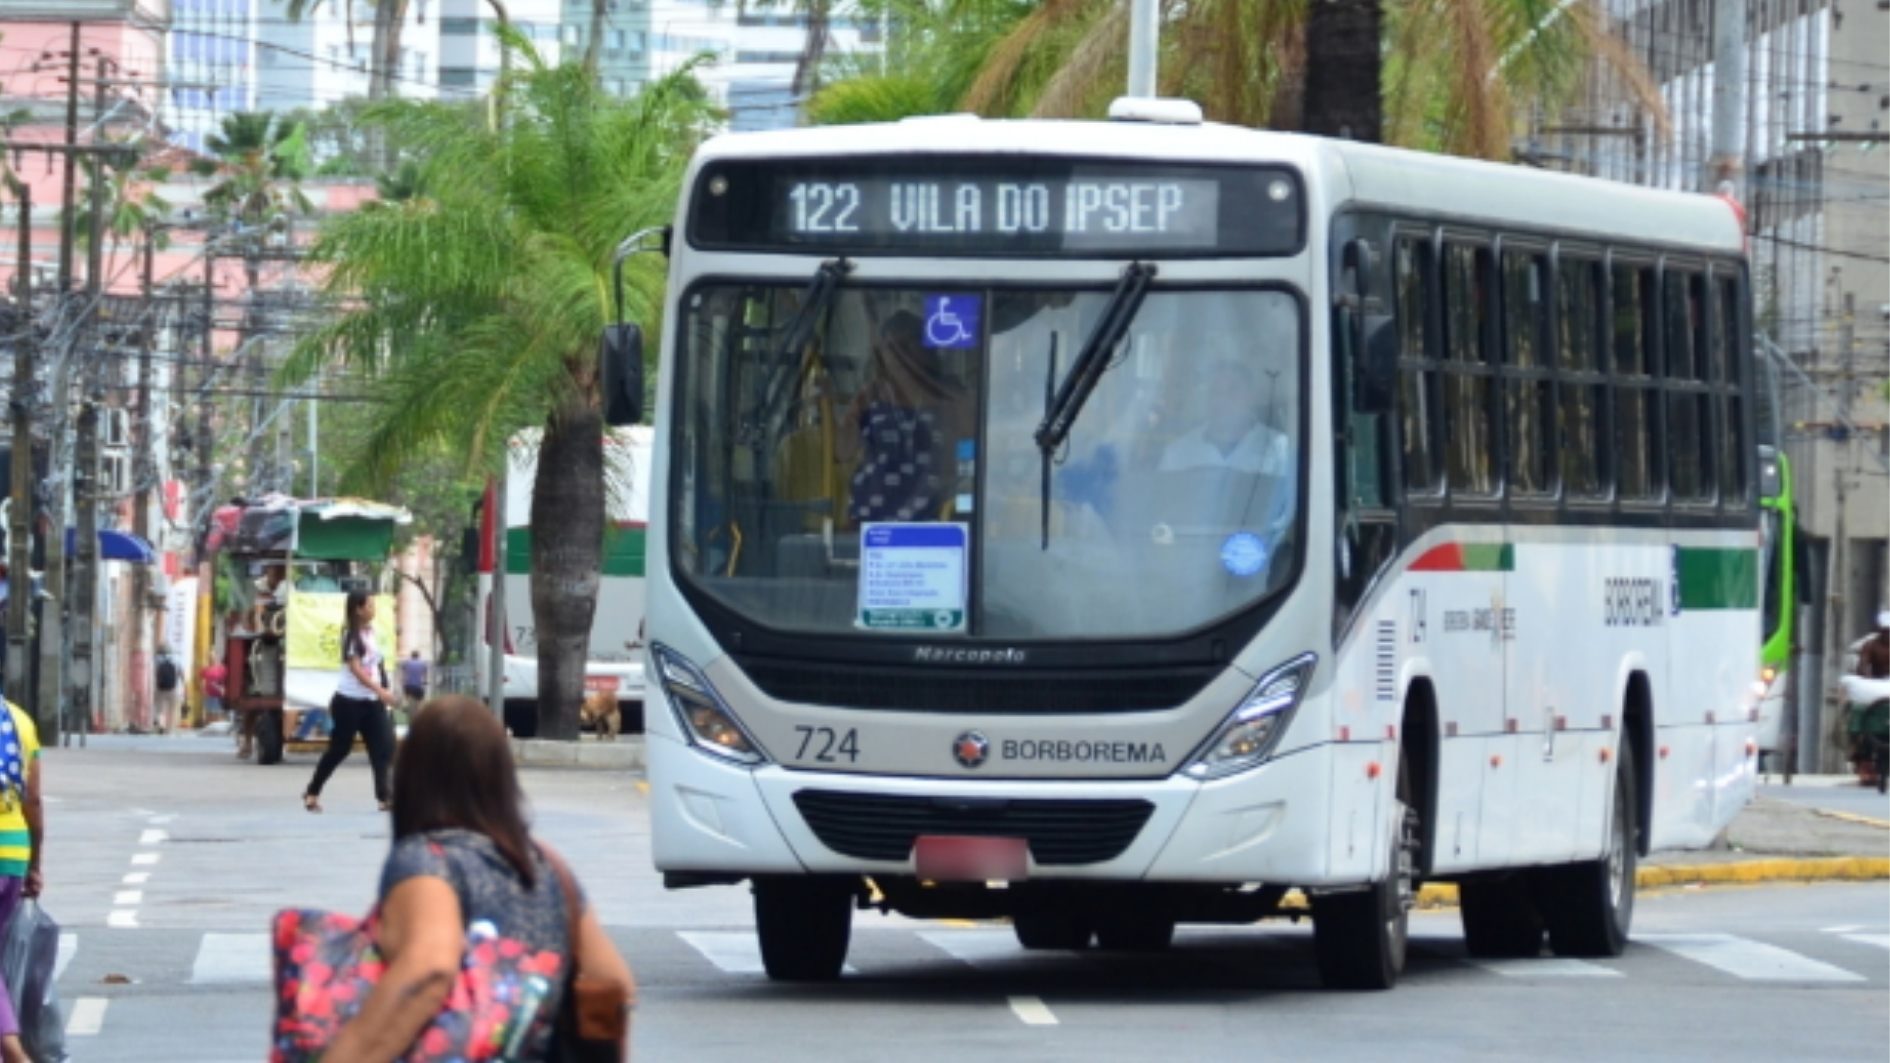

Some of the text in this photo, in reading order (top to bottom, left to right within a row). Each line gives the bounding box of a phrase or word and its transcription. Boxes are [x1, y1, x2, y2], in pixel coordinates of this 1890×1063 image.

[789, 182, 1183, 232] 122 VILA DO IPSEP
[915, 645, 1027, 664] Marcopolo
[794, 725, 860, 763] 724
[1002, 739, 1166, 763] BORBOREMA
